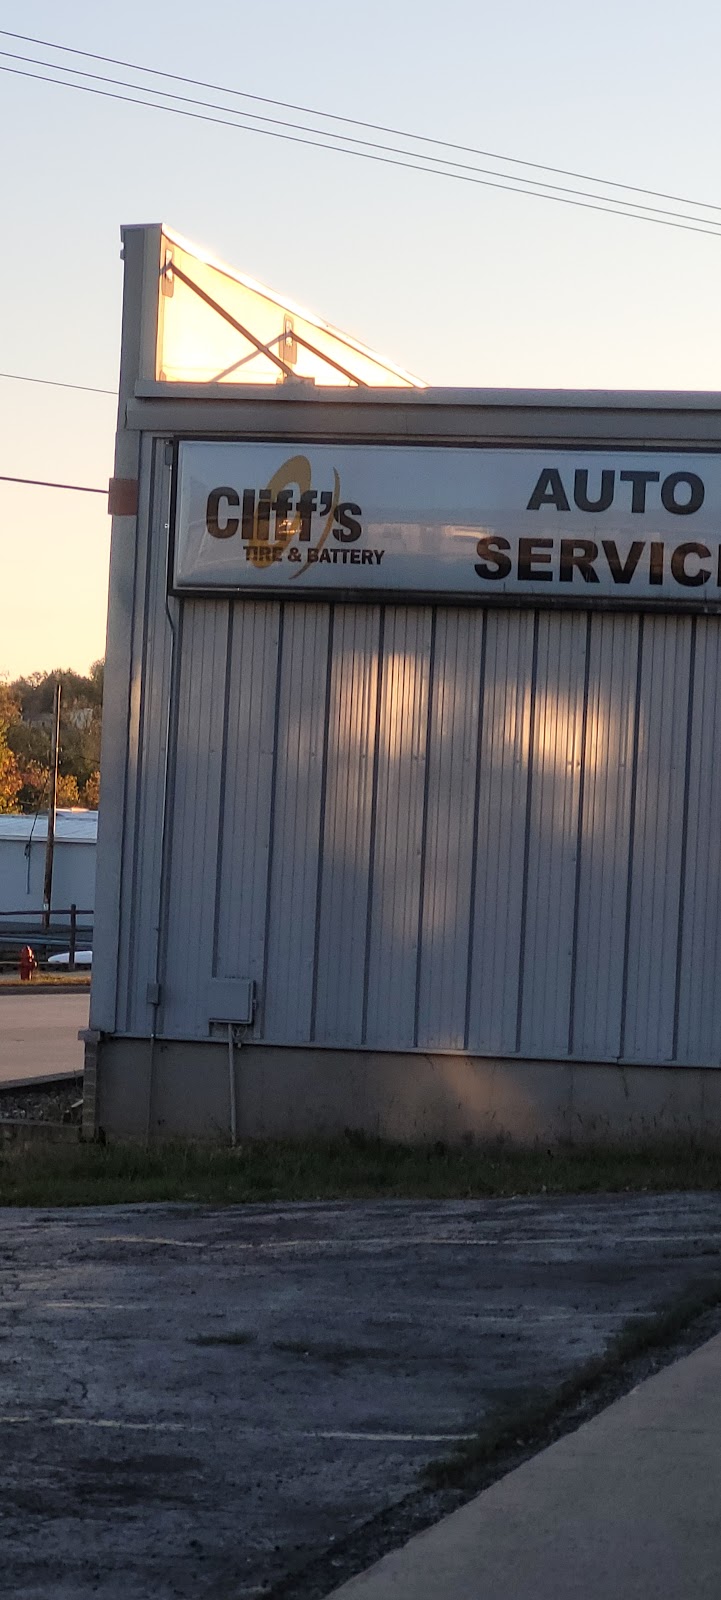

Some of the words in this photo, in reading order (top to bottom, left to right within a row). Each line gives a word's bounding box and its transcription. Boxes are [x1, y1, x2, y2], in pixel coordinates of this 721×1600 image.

[206, 486, 362, 543] Cliff's
[526, 468, 705, 515] AUTO
[243, 545, 283, 563] TIRE
[287, 547, 302, 562] &
[307, 547, 385, 565] BATTERY
[474, 536, 721, 588] SERVIC
